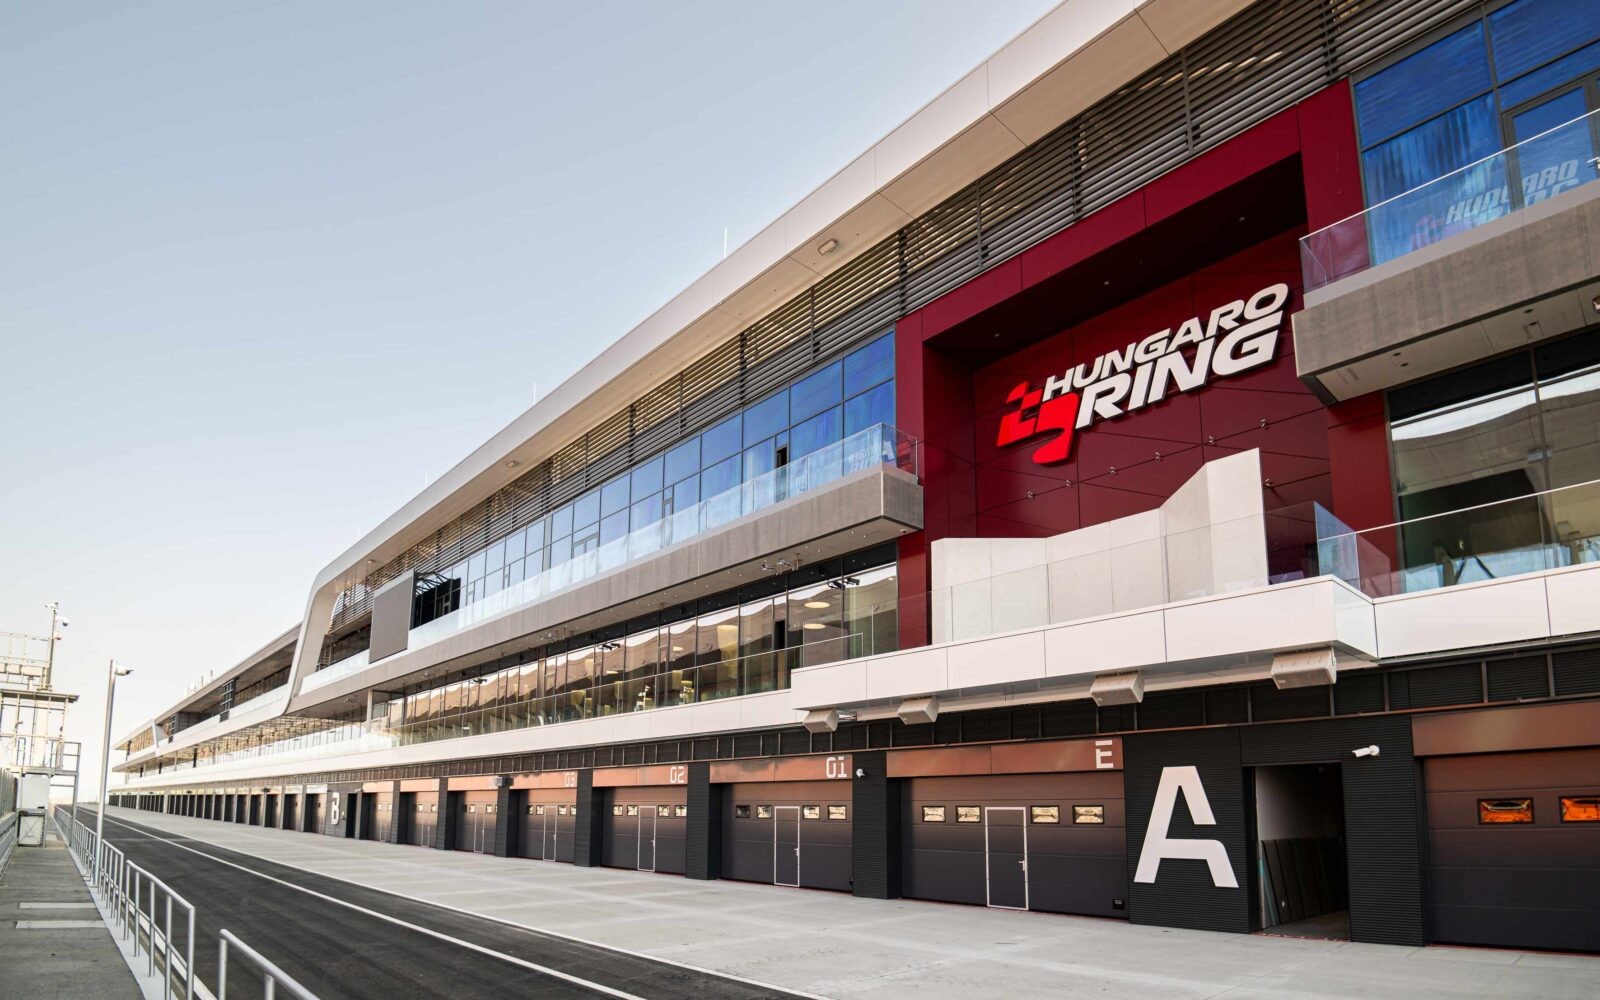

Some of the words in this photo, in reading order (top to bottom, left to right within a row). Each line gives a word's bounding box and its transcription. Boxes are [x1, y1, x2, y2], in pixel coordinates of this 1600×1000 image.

[1042, 283, 1288, 401] HUNGARO
[1075, 310, 1283, 429] RING
[826, 756, 848, 778] 01
[1095, 740, 1113, 768] E
[670, 766, 685, 784] 02
[331, 792, 340, 825] B
[1134, 766, 1239, 888] A
